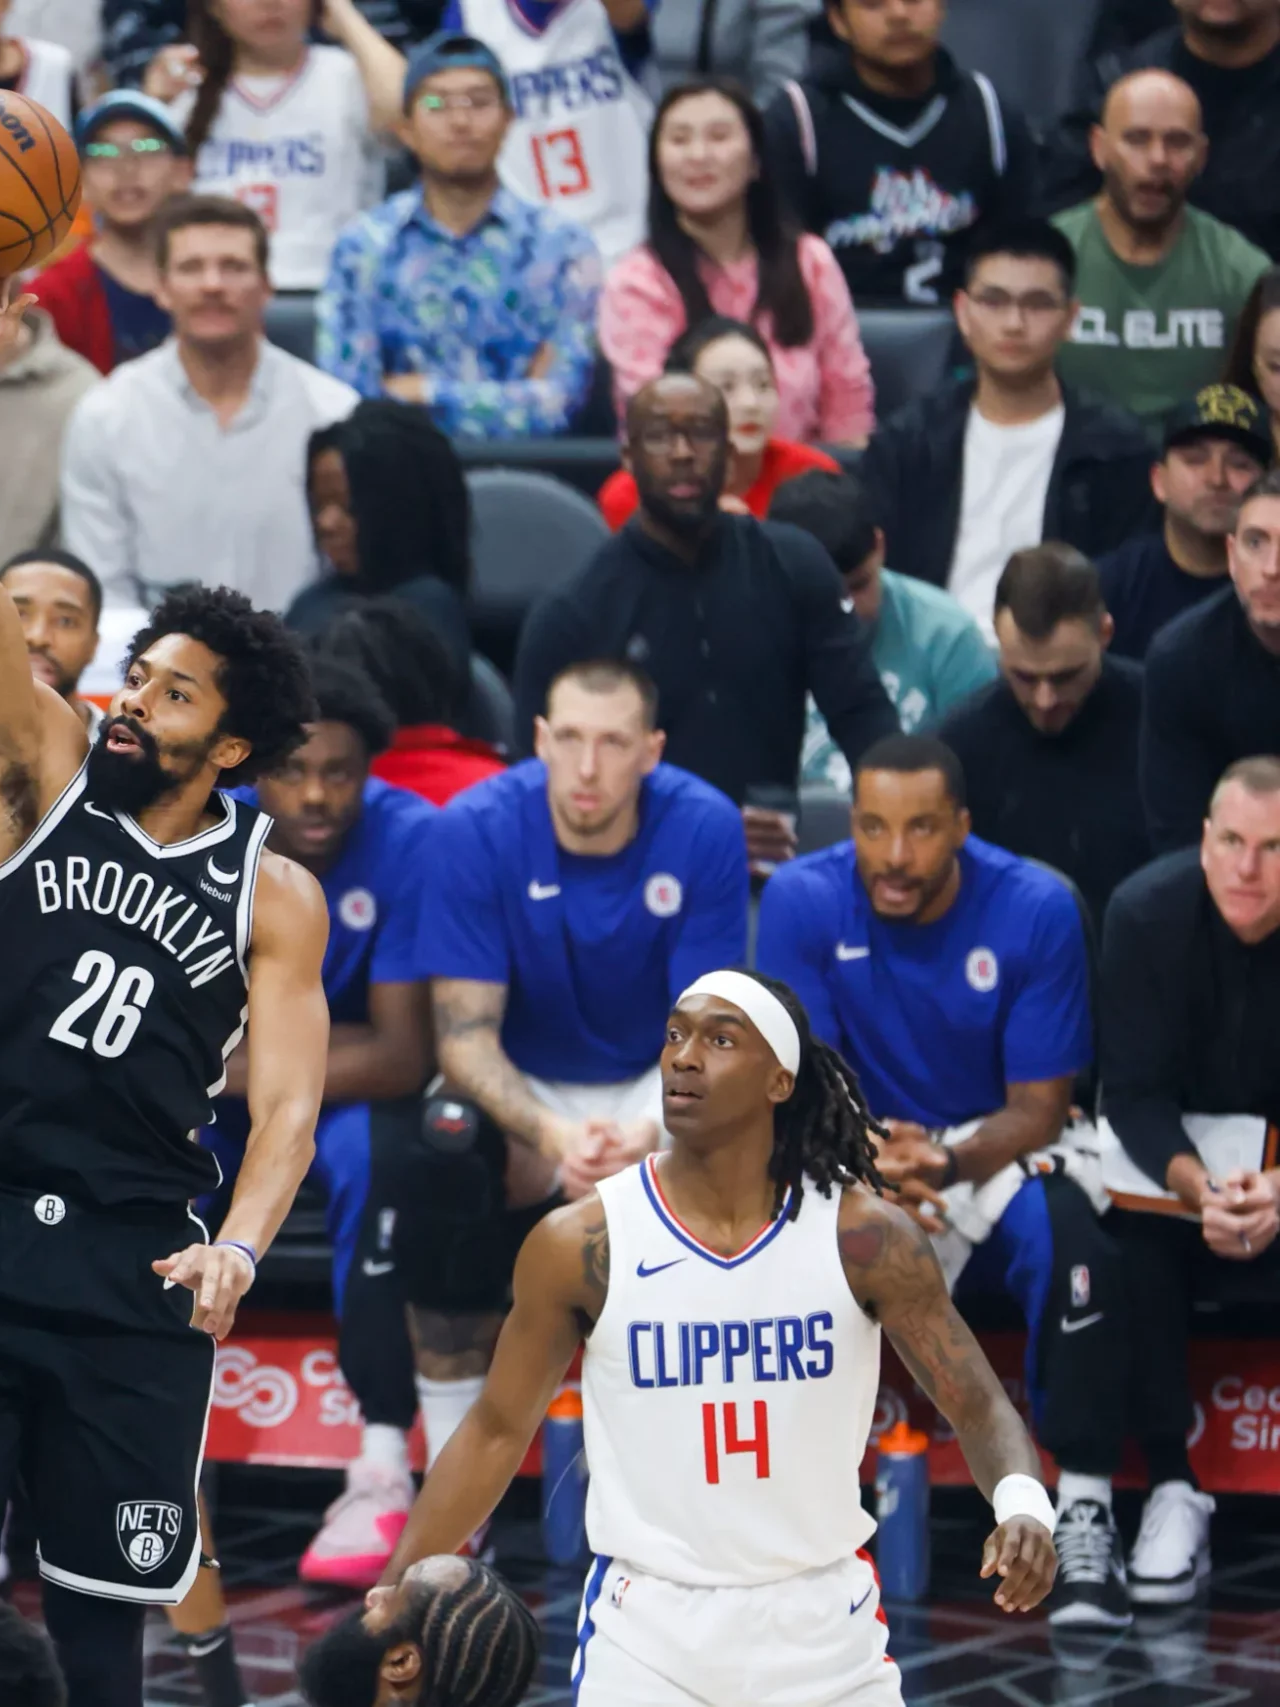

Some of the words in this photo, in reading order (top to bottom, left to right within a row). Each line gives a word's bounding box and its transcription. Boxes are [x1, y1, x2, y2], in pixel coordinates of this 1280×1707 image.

[531, 127, 592, 201] 13
[1123, 308, 1224, 350] ELITE
[35, 856, 234, 989] BROOKLYN
[200, 878, 232, 903] Webull
[48, 950, 154, 1058] 26
[627, 1310, 834, 1389] CLIPPERS
[702, 1400, 770, 1484] 14
[120, 1504, 179, 1535] NETS
